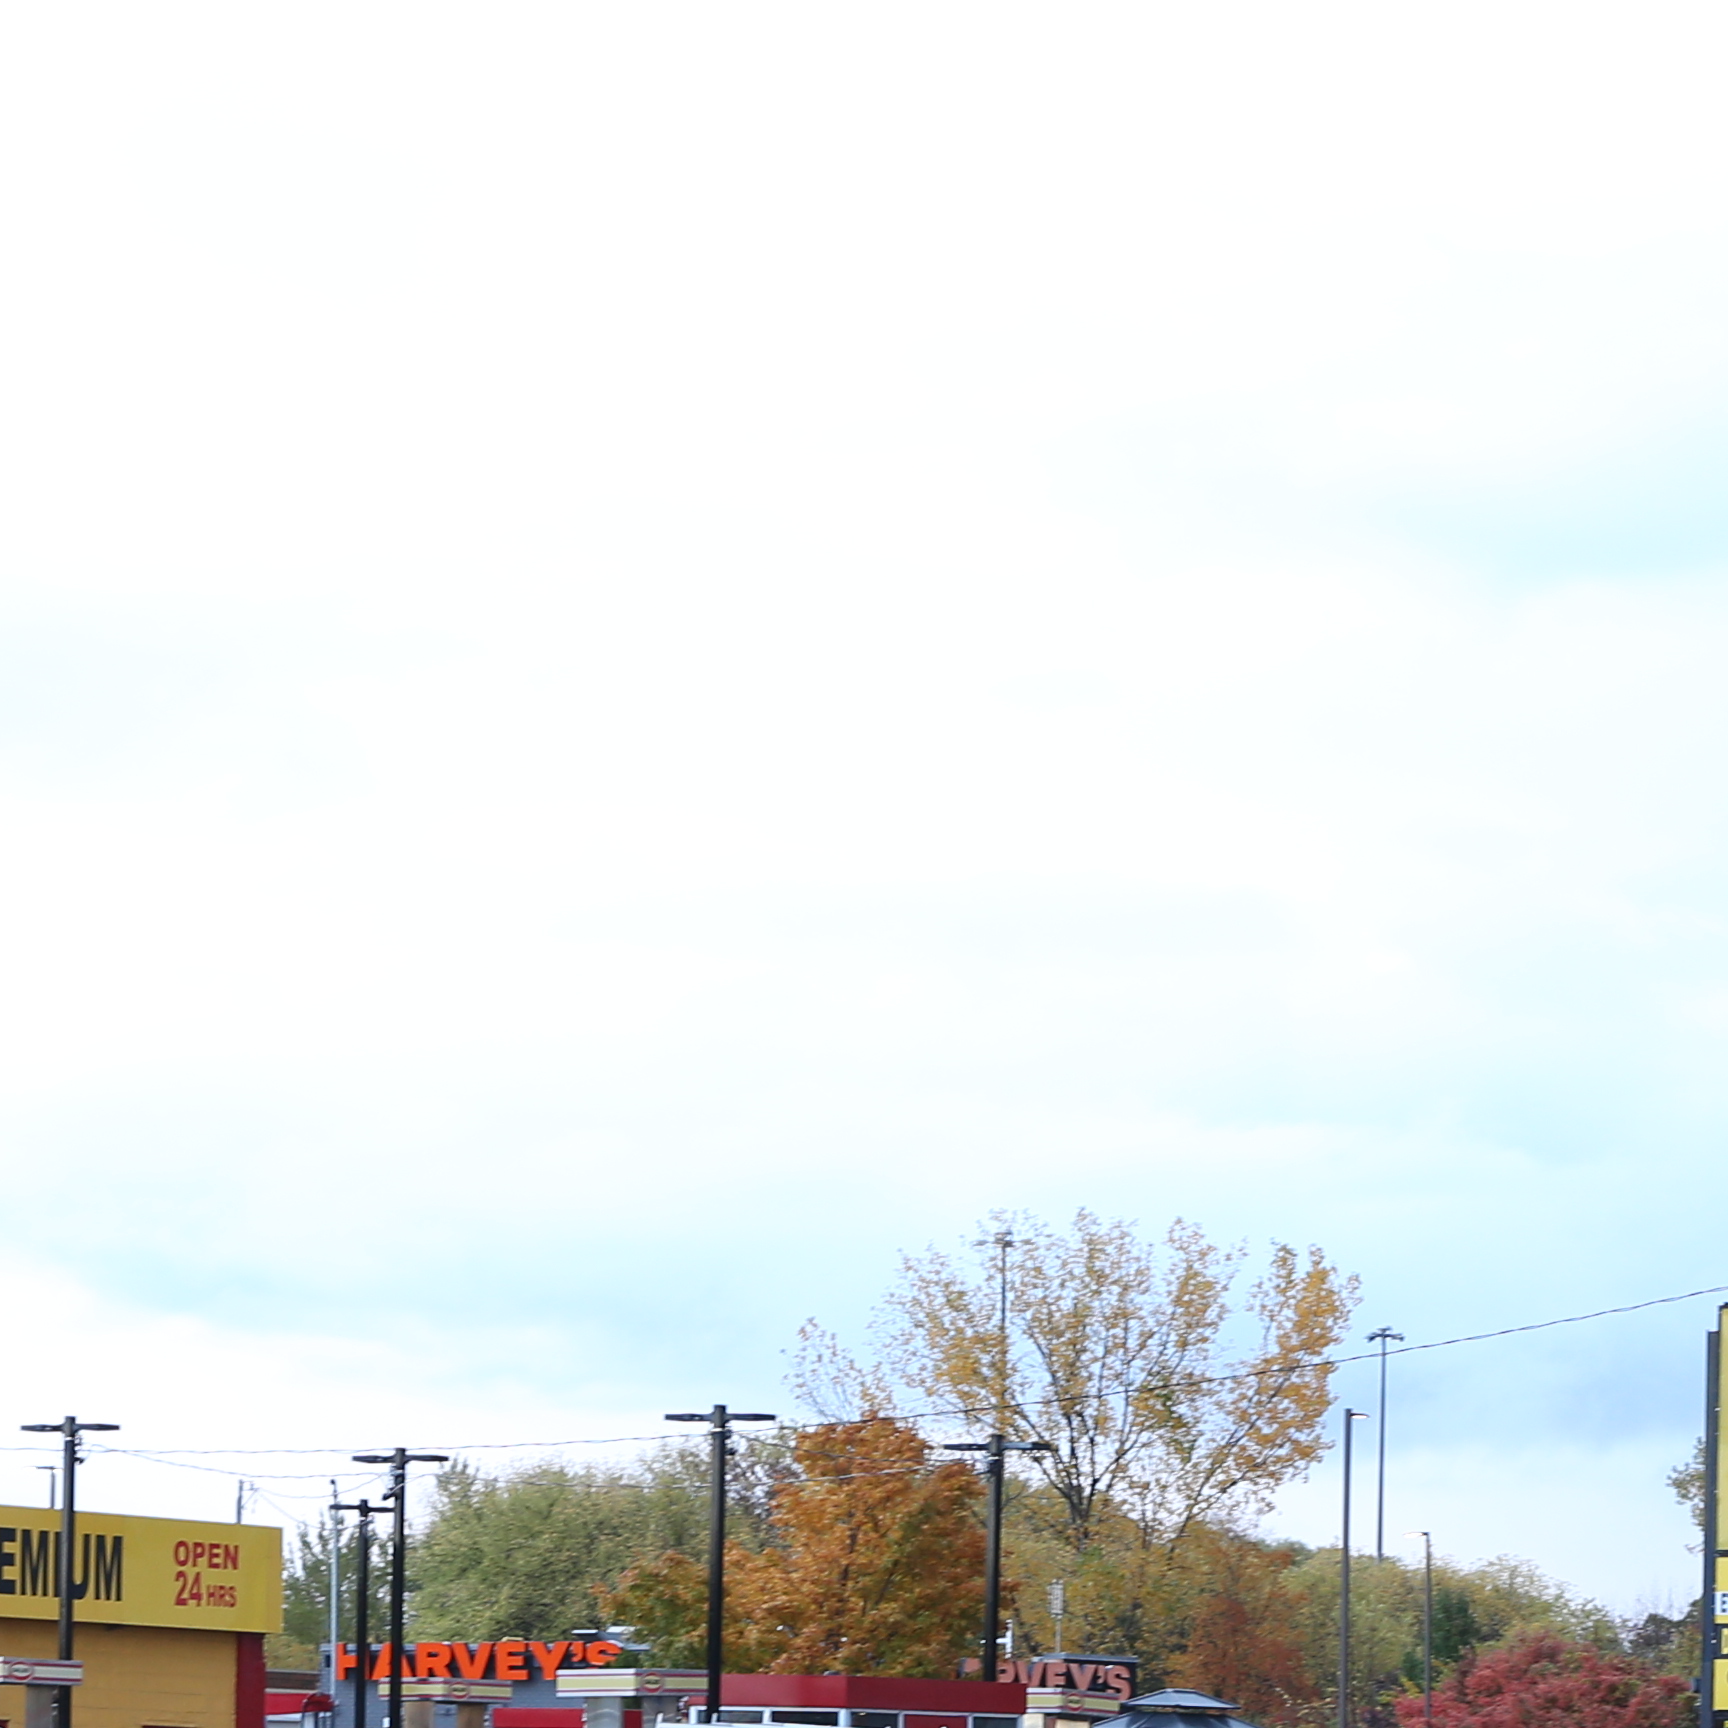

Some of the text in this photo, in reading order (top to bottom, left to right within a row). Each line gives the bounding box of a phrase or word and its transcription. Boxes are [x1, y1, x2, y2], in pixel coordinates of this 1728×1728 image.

[174, 1540, 240, 1570] OPEN
[174, 1570, 238, 1608] 24 HRS
[335, 1640, 621, 1681] HARVEY'S
